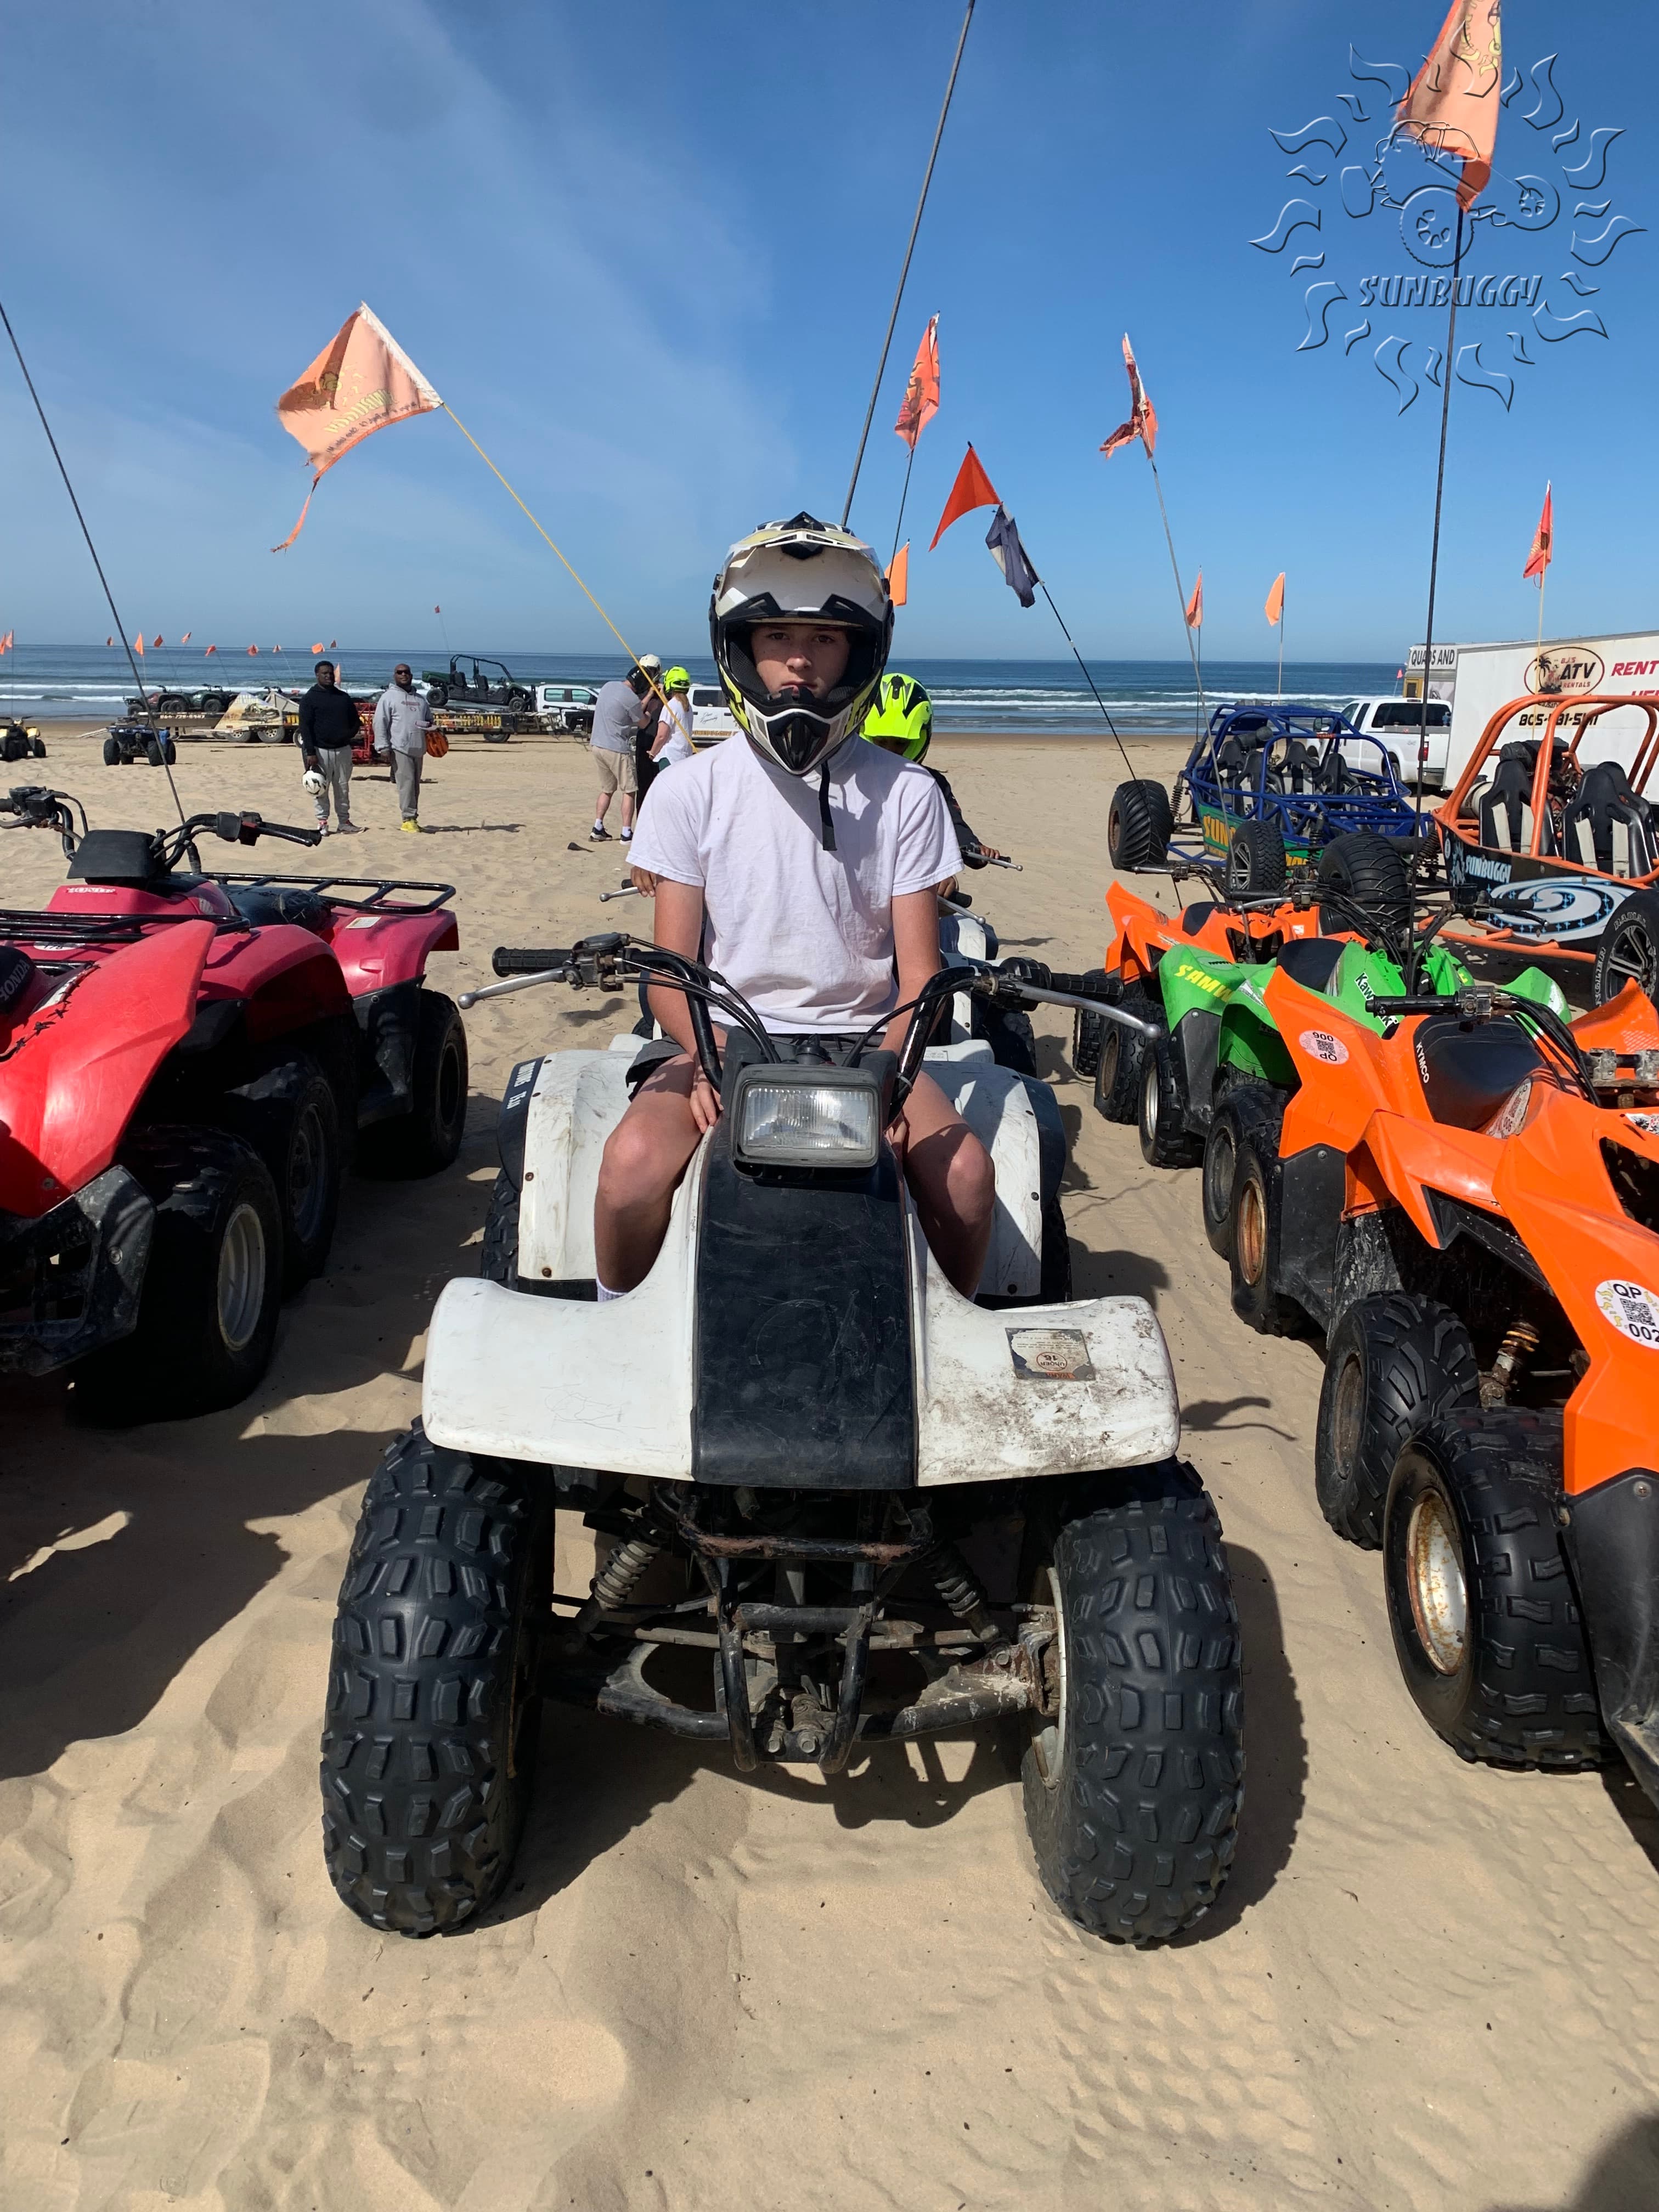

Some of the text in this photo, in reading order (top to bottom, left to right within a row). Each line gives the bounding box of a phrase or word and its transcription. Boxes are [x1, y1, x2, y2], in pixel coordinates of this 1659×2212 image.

[1411, 649, 1455, 666] QUAS AND
[1560, 662, 1596, 680] ATV
[1465, 854, 1512, 884] SUNBUGGY
[1312, 1032, 1334, 1042] 006
[1319, 1052, 1338, 1062] QP
[1415, 1042, 1430, 1084] KYMCO
[1613, 1283, 1642, 1299] QP
[1628, 1323, 1659, 1343] 002
